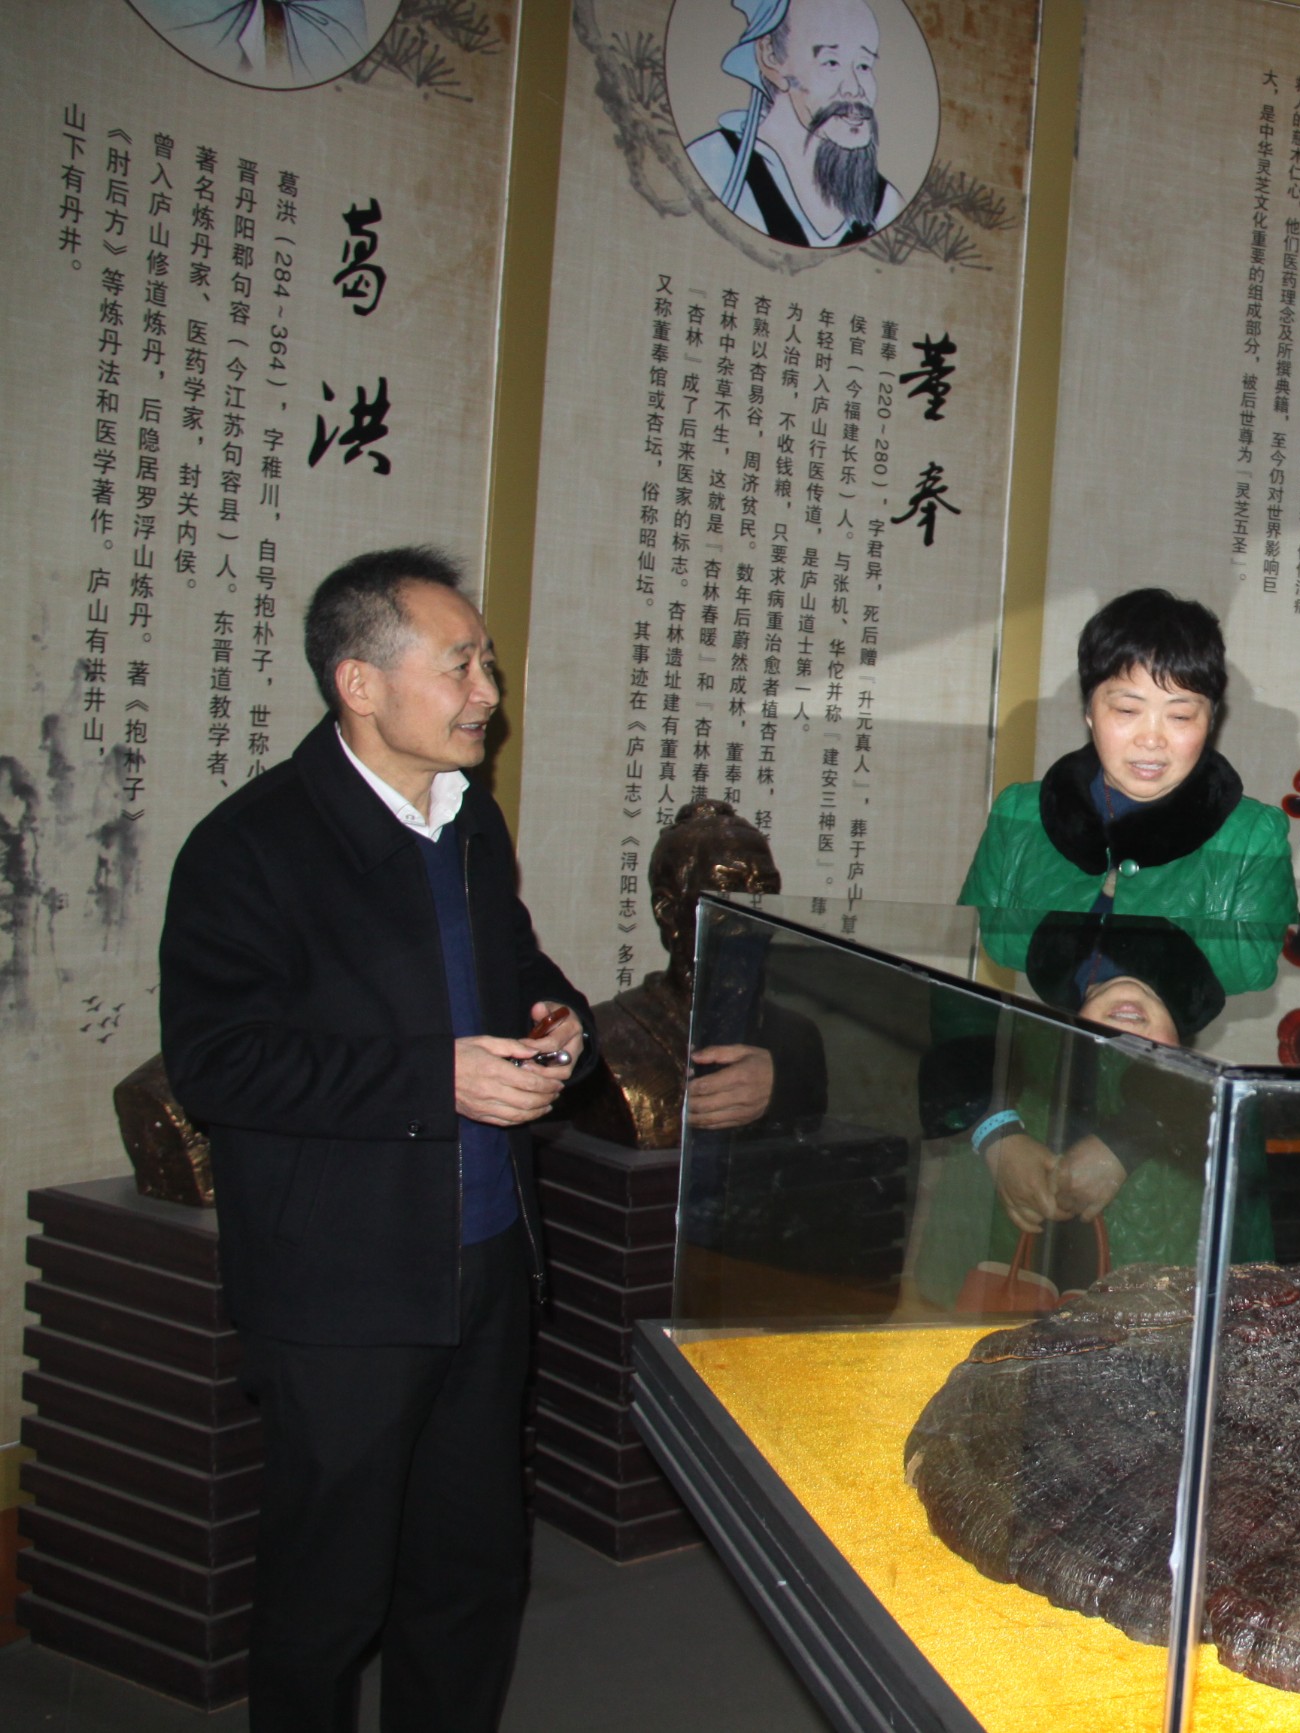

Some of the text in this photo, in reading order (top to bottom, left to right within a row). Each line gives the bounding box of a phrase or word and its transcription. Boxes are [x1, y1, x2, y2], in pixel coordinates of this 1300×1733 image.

[58, 103, 86, 271] 山下有丹井。
[308, 197, 391, 475] 葛洪
[174, 145, 217, 589] 著名炼丹家、医药学家，封关内侯。
[793, 308, 835, 732] 年轻时入庐山行医传道，是庐山道士第一人。
[891, 332, 961, 546] 董奉
[754, 302, 803, 842] 为人治病，不收钱粮，只要求病重治愈者植杏五株，轻
